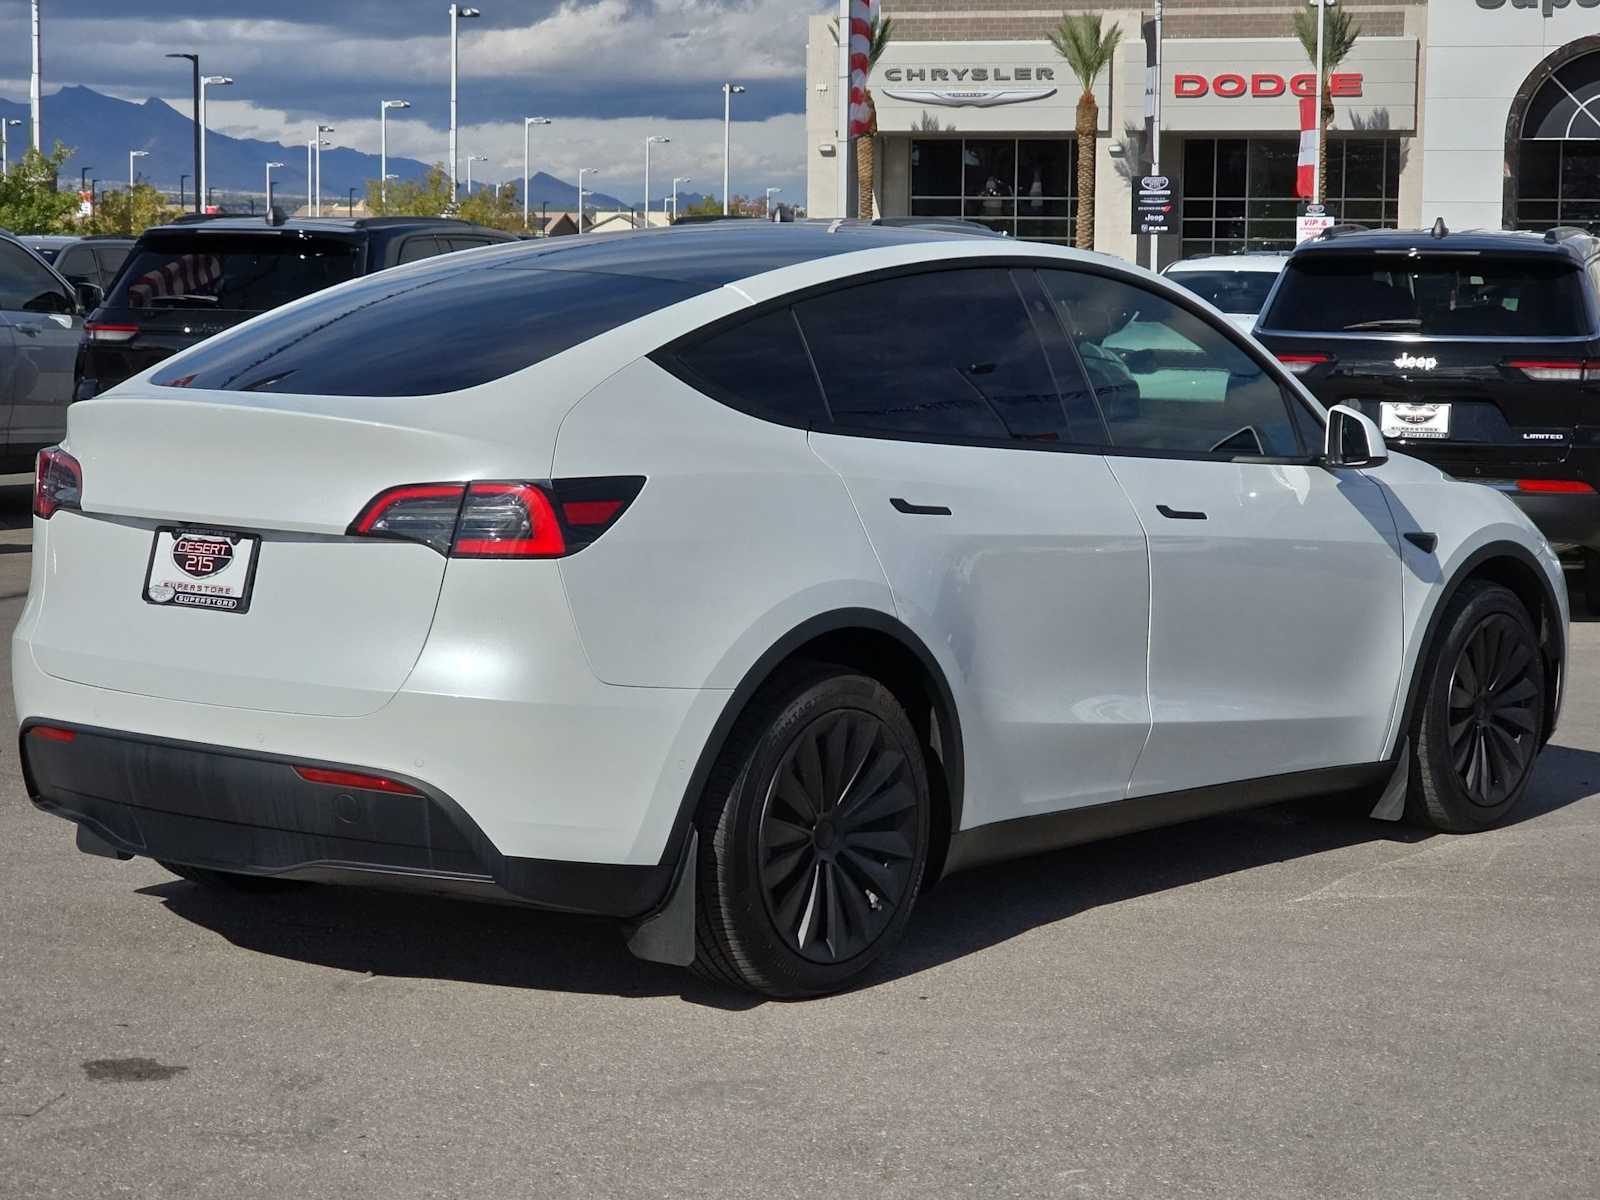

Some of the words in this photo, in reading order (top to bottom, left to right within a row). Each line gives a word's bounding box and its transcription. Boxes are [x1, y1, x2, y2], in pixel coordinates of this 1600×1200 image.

[884, 67, 1056, 82] CHRYSLER
[1174, 73, 1363, 97] DODGE
[1144, 213, 1164, 222] Jeep
[1393, 352, 1438, 371] Jeep
[177, 541, 229, 555] DESERT
[185, 555, 214, 572] 215
[163, 582, 231, 594] SUPERSTORE
[178, 594, 234, 607] SUPERSTORE
